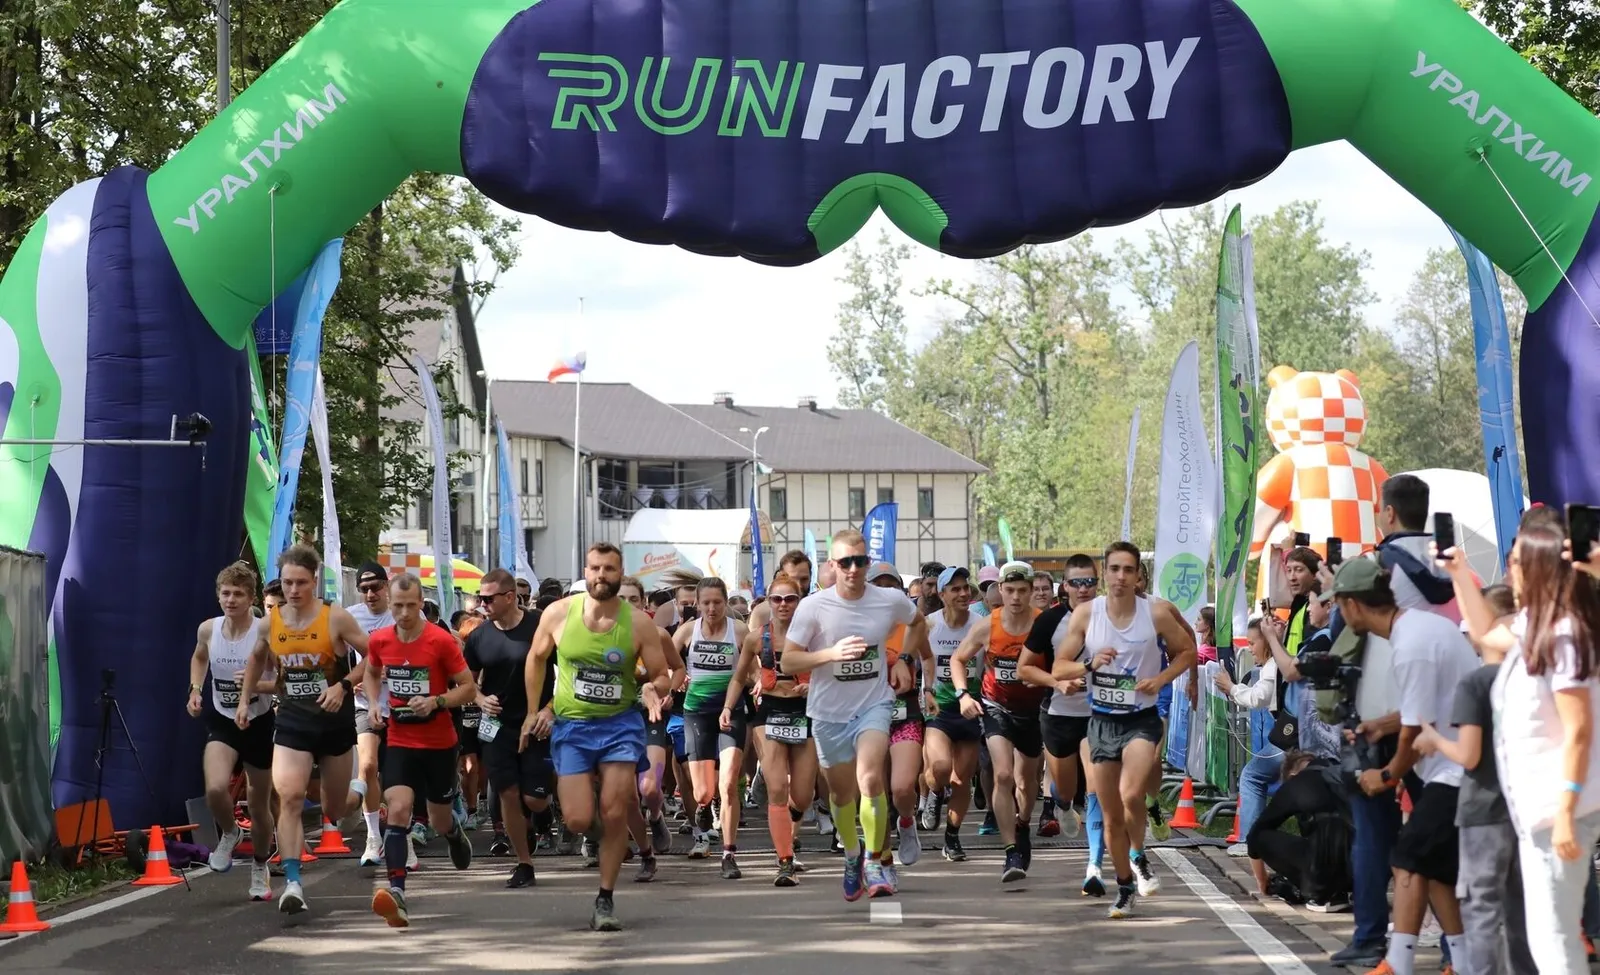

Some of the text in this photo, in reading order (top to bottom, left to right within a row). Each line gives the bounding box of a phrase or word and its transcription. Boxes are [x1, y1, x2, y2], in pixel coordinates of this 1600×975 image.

[1409, 50, 1593, 198] УРАЛХИМ
[172, 82, 347, 235] УРАЛХИМ
[278, 652, 322, 668] МГУ
[699, 653, 727, 665] 748
[841, 661, 873, 675] 589
[1000, 669, 1017, 680] 60
[291, 682, 322, 695] 566
[392, 680, 422, 694] 555
[582, 683, 615, 698] 568
[222, 692, 241, 703] 52
[1099, 688, 1125, 703] 613
[479, 721, 493, 735] 38
[771, 726, 801, 738] 688
